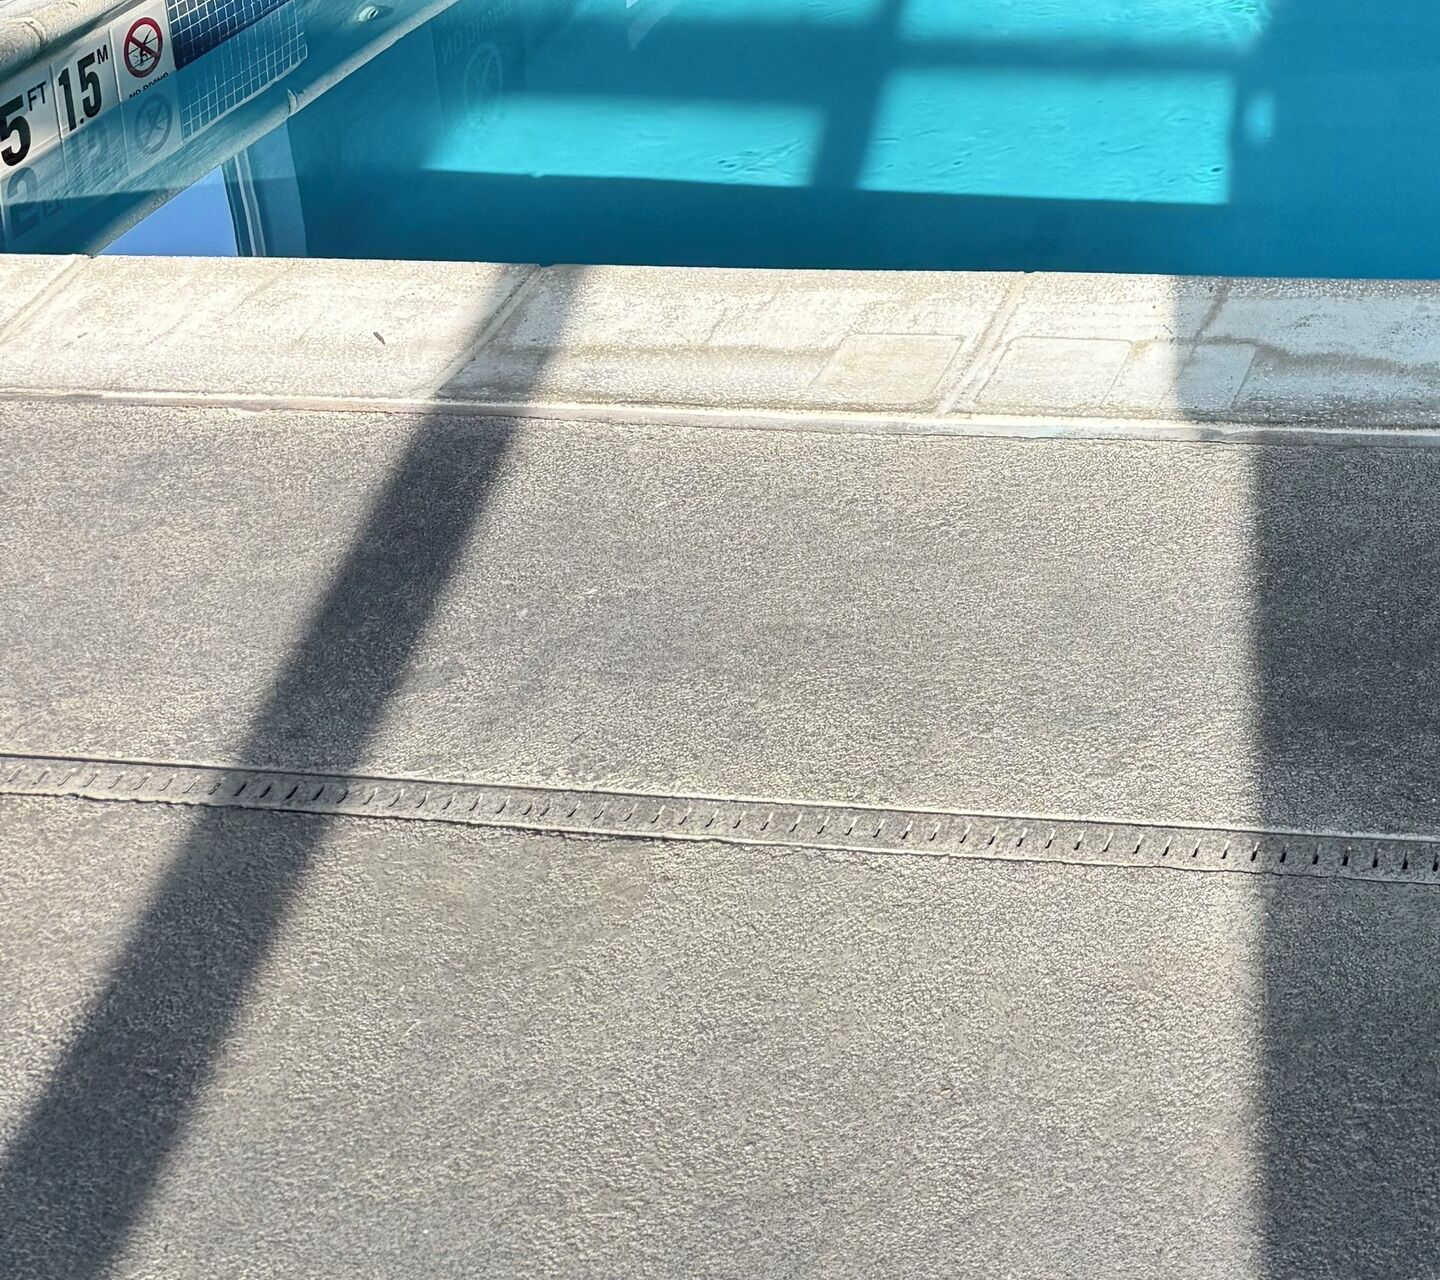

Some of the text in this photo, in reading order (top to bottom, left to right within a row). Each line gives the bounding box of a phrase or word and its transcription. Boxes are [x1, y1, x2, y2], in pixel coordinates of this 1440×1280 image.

[0, 95, 31, 167] 5
[27, 81, 47, 111] FT
[97, 44, 109, 65] M
